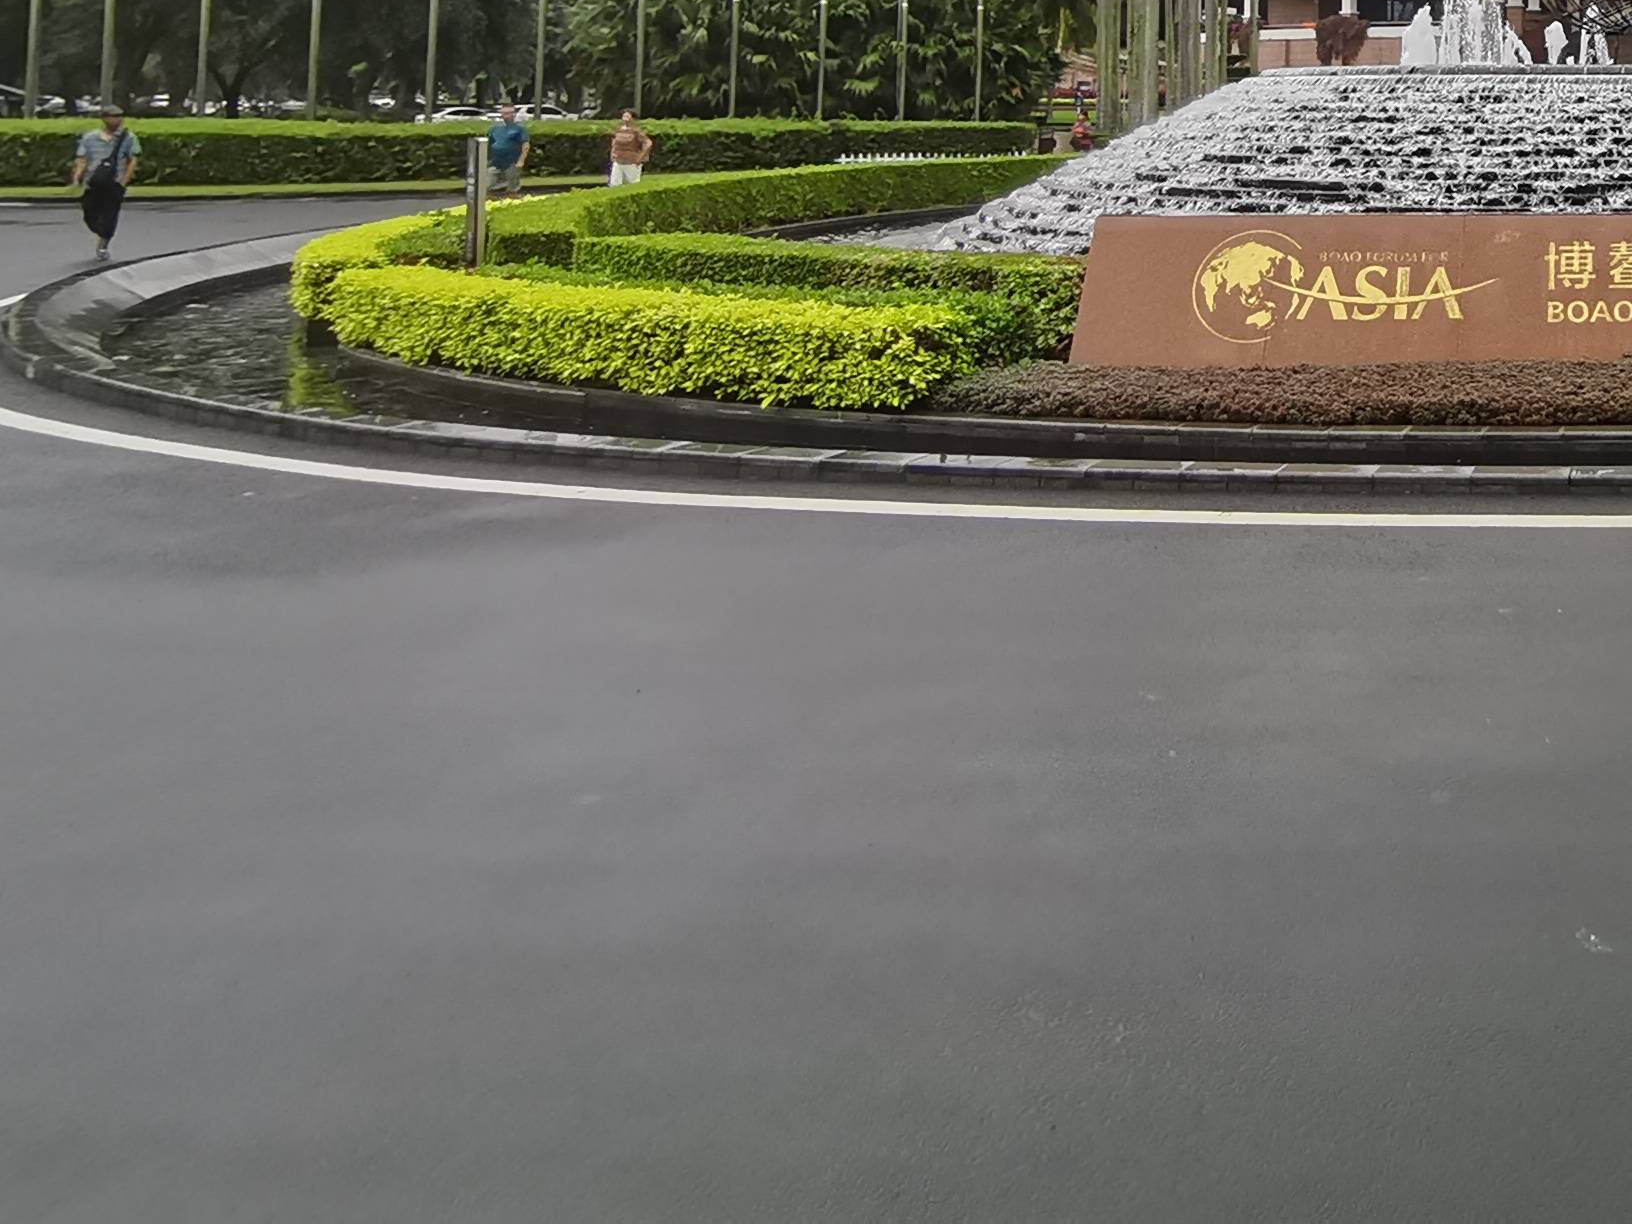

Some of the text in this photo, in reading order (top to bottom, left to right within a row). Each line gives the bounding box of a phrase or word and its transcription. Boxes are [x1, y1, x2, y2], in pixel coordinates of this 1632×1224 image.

[1319, 251, 1361, 263] BOAO
[1366, 251, 1418, 263] FORUM
[1296, 266, 1464, 320] ASIA
